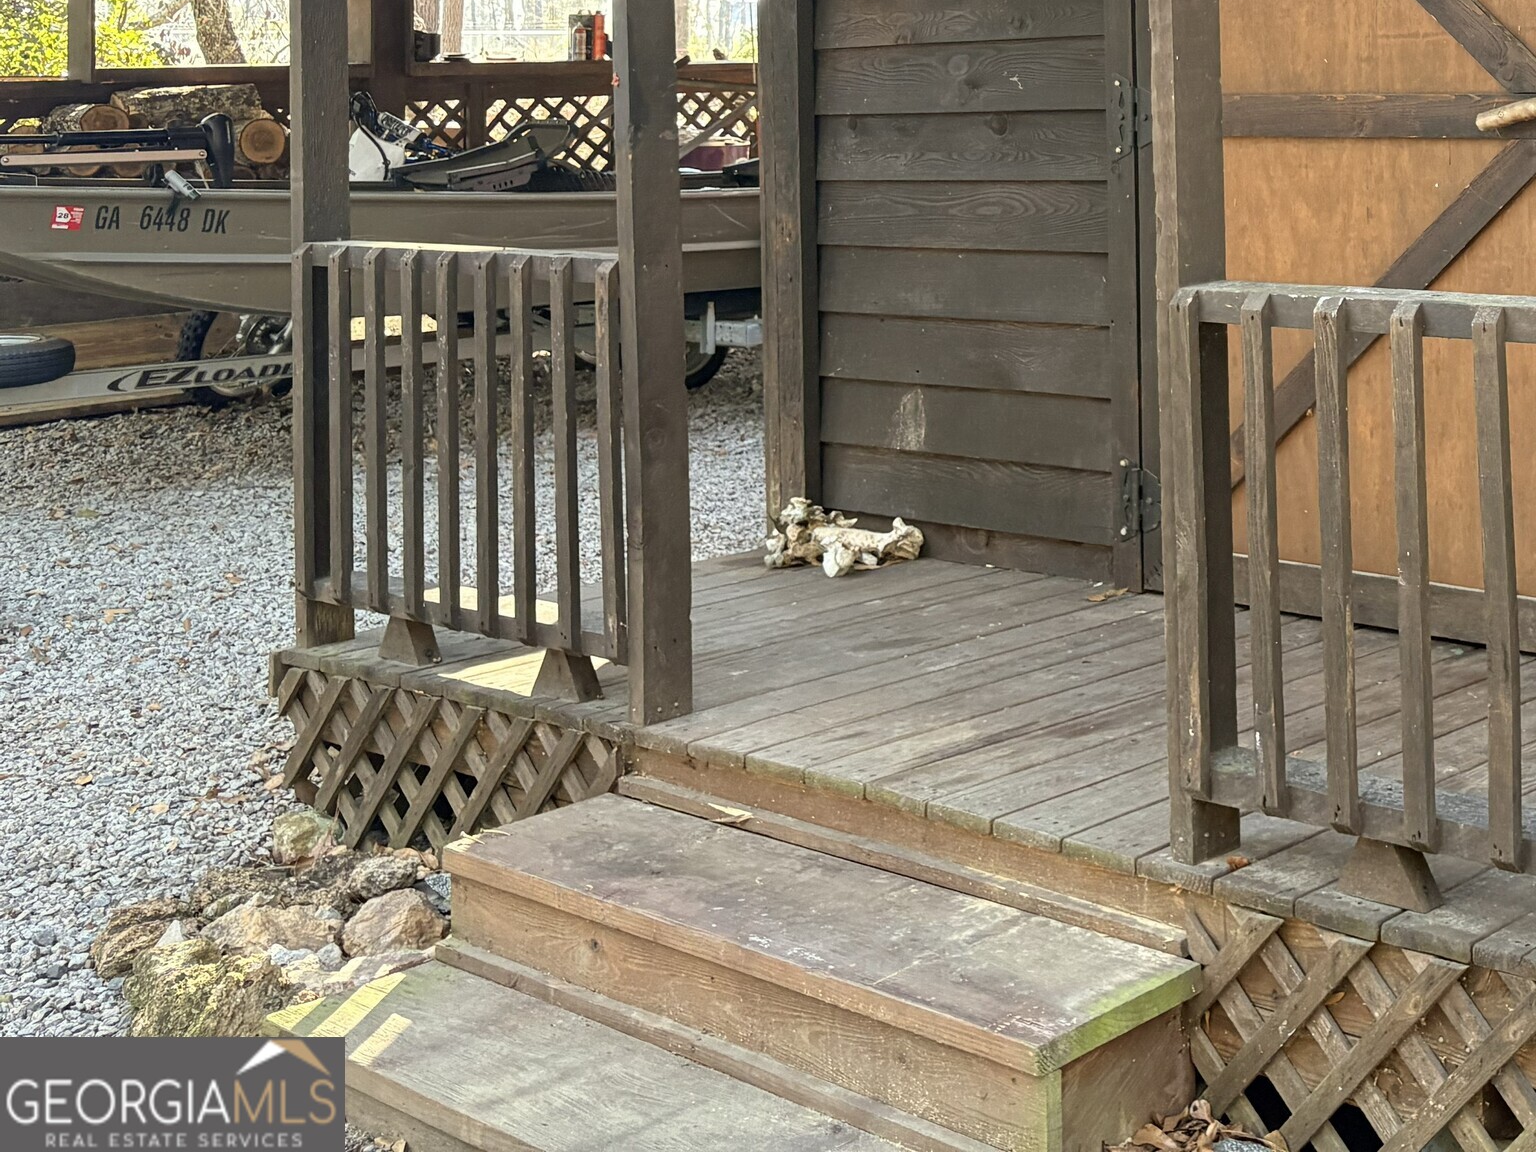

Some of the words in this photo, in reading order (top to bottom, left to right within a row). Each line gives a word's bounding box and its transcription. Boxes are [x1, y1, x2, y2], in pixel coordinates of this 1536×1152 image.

[95, 205, 120, 230] GA
[139, 205, 191, 232] 6448
[202, 208, 231, 234] DK
